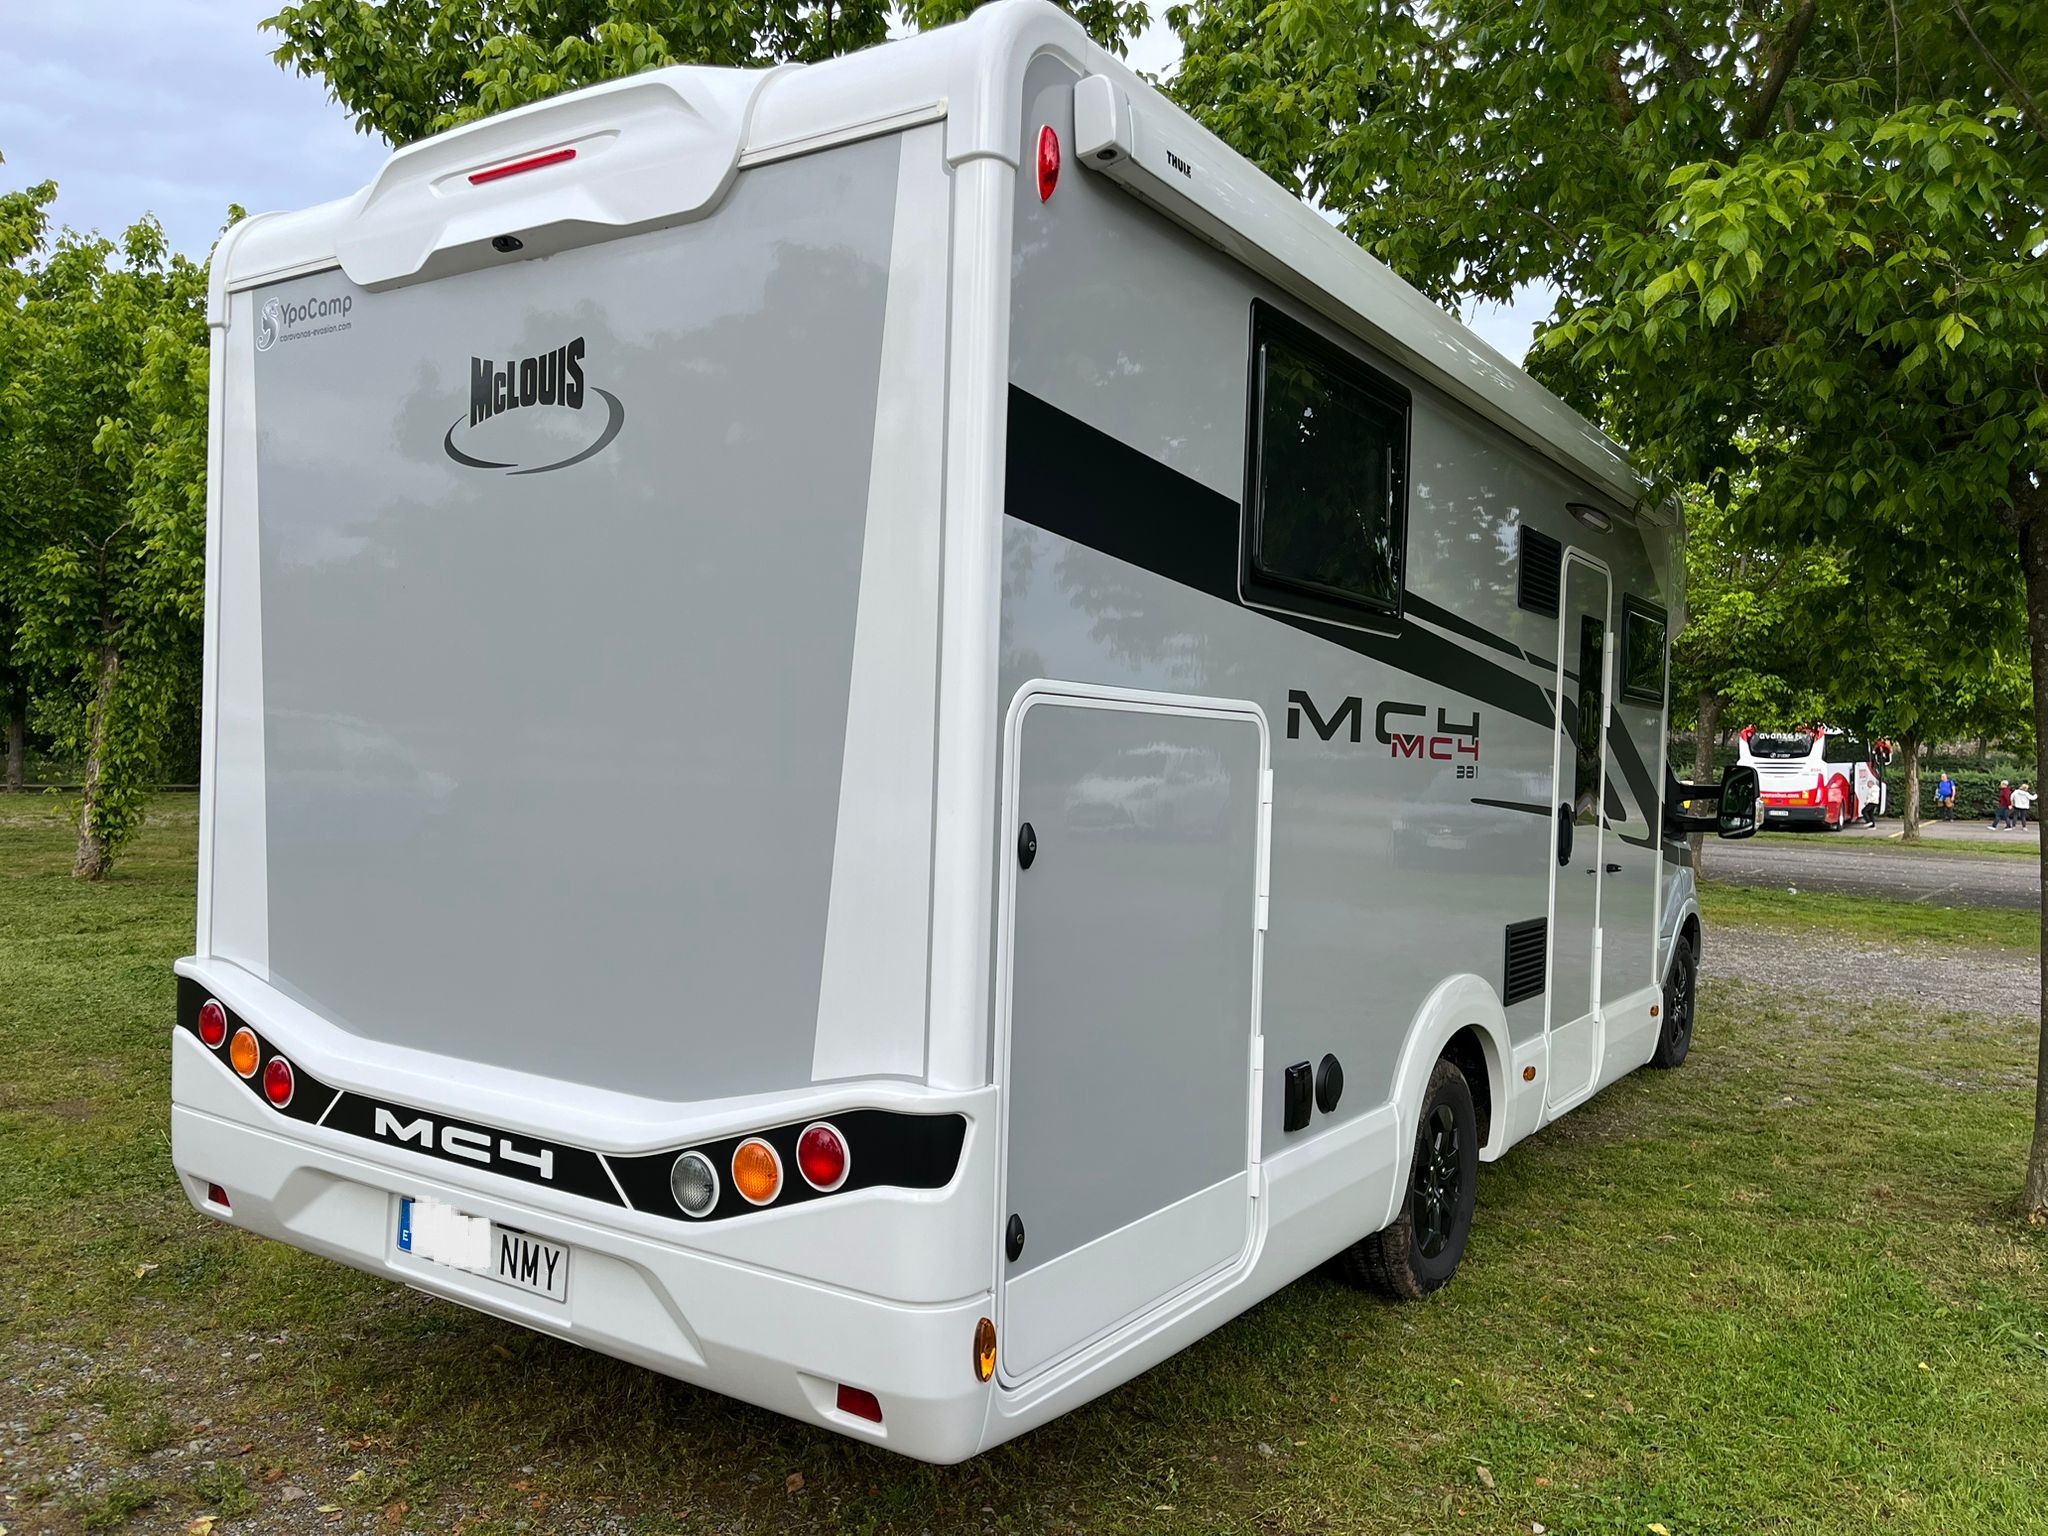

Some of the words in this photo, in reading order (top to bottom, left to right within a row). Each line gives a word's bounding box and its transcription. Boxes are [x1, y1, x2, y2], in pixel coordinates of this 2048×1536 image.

[1166, 150, 1192, 179] THULE
[280, 295, 353, 329] YpoCamp
[1286, 688, 1481, 745] MC4
[1391, 733, 1480, 761] MC4
[374, 1107, 554, 1180] MC4
[402, 1229, 409, 1242] E
[499, 1234, 561, 1292] NMY
